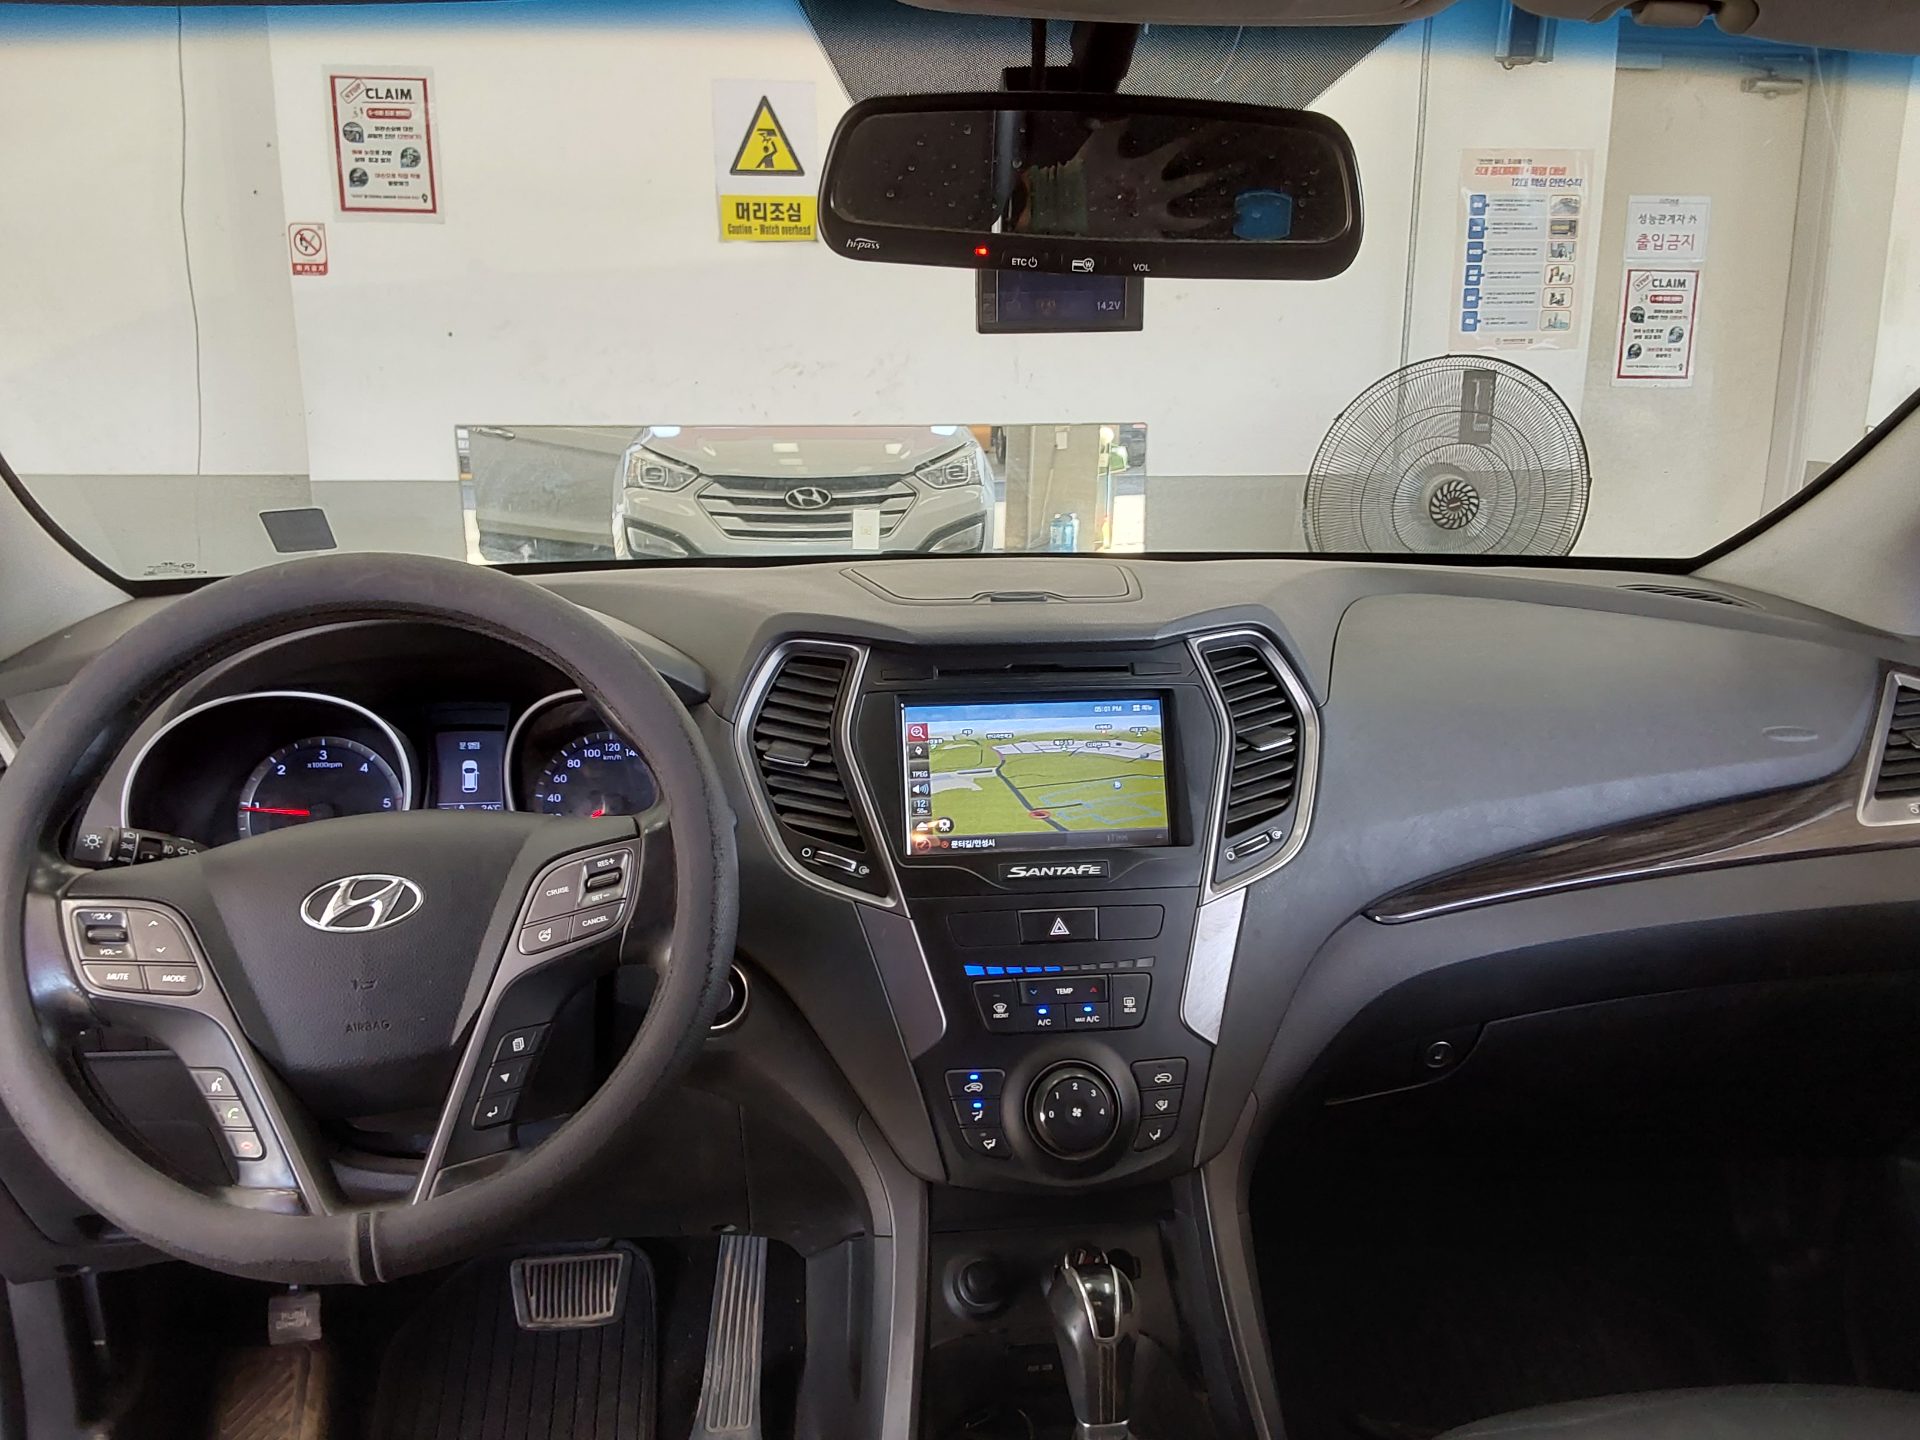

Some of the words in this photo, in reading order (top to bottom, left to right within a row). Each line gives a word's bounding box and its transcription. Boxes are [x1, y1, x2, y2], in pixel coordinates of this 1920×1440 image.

[365, 88, 413, 100] CLAIM
[735, 202, 801, 222] 머리조심
[1638, 213, 1686, 225] 성능관계자
[728, 223, 753, 235] Caution
[760, 224, 780, 236] Watch
[781, 224, 811, 236] overhead
[1636, 233, 1695, 251] 출입금지
[1011, 257, 1027, 266] ETC
[1133, 263, 1151, 271] VOL
[1651, 278, 1687, 288] CLAIM
[604, 743, 620, 752] 120
[319, 750, 328, 760] 3
[583, 749, 601, 758] 100
[625, 748, 639, 757] 14
[360, 763, 368, 773] 4
[567, 759, 581, 768] 80
[277, 764, 286, 775] 2
[912, 770, 928, 778] TPEG
[553, 774, 567, 784] 60
[382, 797, 391, 808] 5
[547, 793, 561, 803] 40
[546, 886, 570, 897] CRUISE
[582, 915, 609, 927] CANCEL
[106, 972, 129, 981] MUTE
[162, 974, 188, 983] MODE
[1056, 987, 1074, 995] TEMP
[1037, 1018, 1052, 1026] A/C
[1072, 1082, 1078, 1091] 2
[1055, 1091, 1060, 1100] 1
[1090, 1089, 1097, 1097] 3
[1049, 1110, 1055, 1119] 0
[1099, 1107, 1105, 1115] 4
